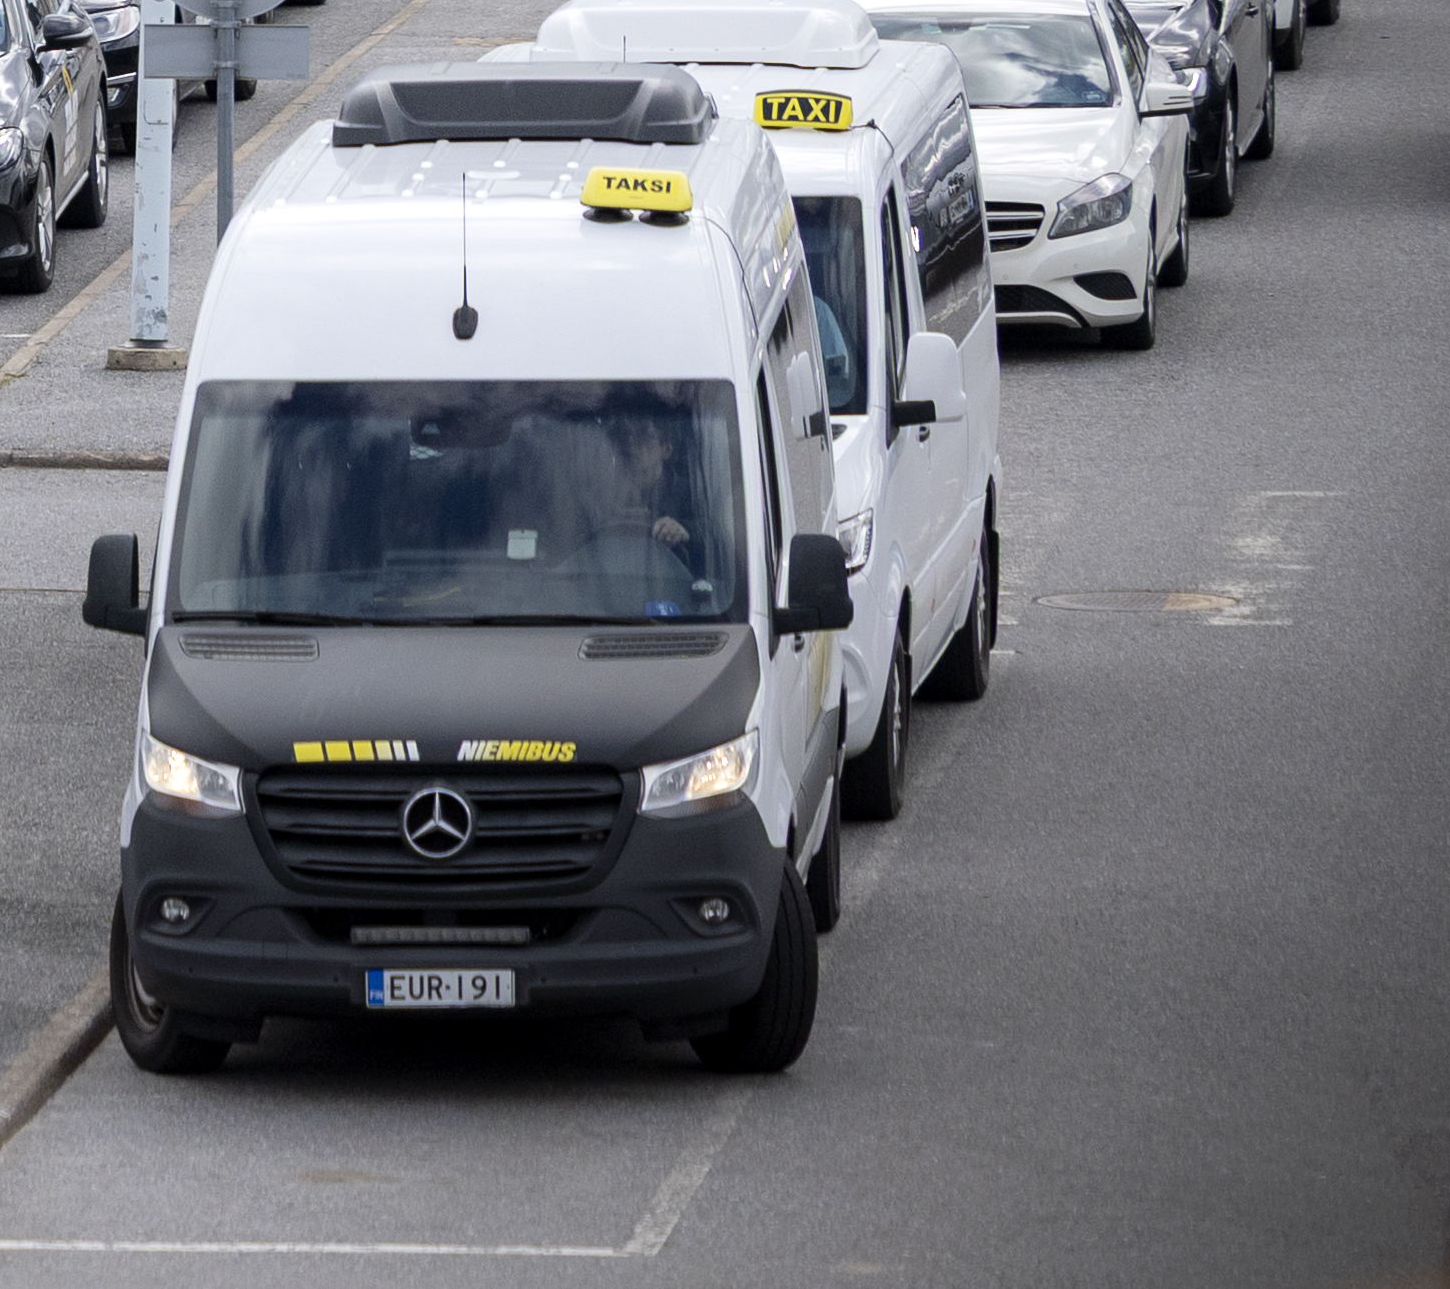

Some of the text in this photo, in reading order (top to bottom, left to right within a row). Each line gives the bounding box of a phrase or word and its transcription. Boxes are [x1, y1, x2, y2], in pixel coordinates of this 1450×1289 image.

[766, 97, 836, 123] TAXI
[603, 176, 672, 194] TAKSI
[456, 739, 577, 762] NIEMIBUS
[389, 974, 500, 1001] EUR-191
